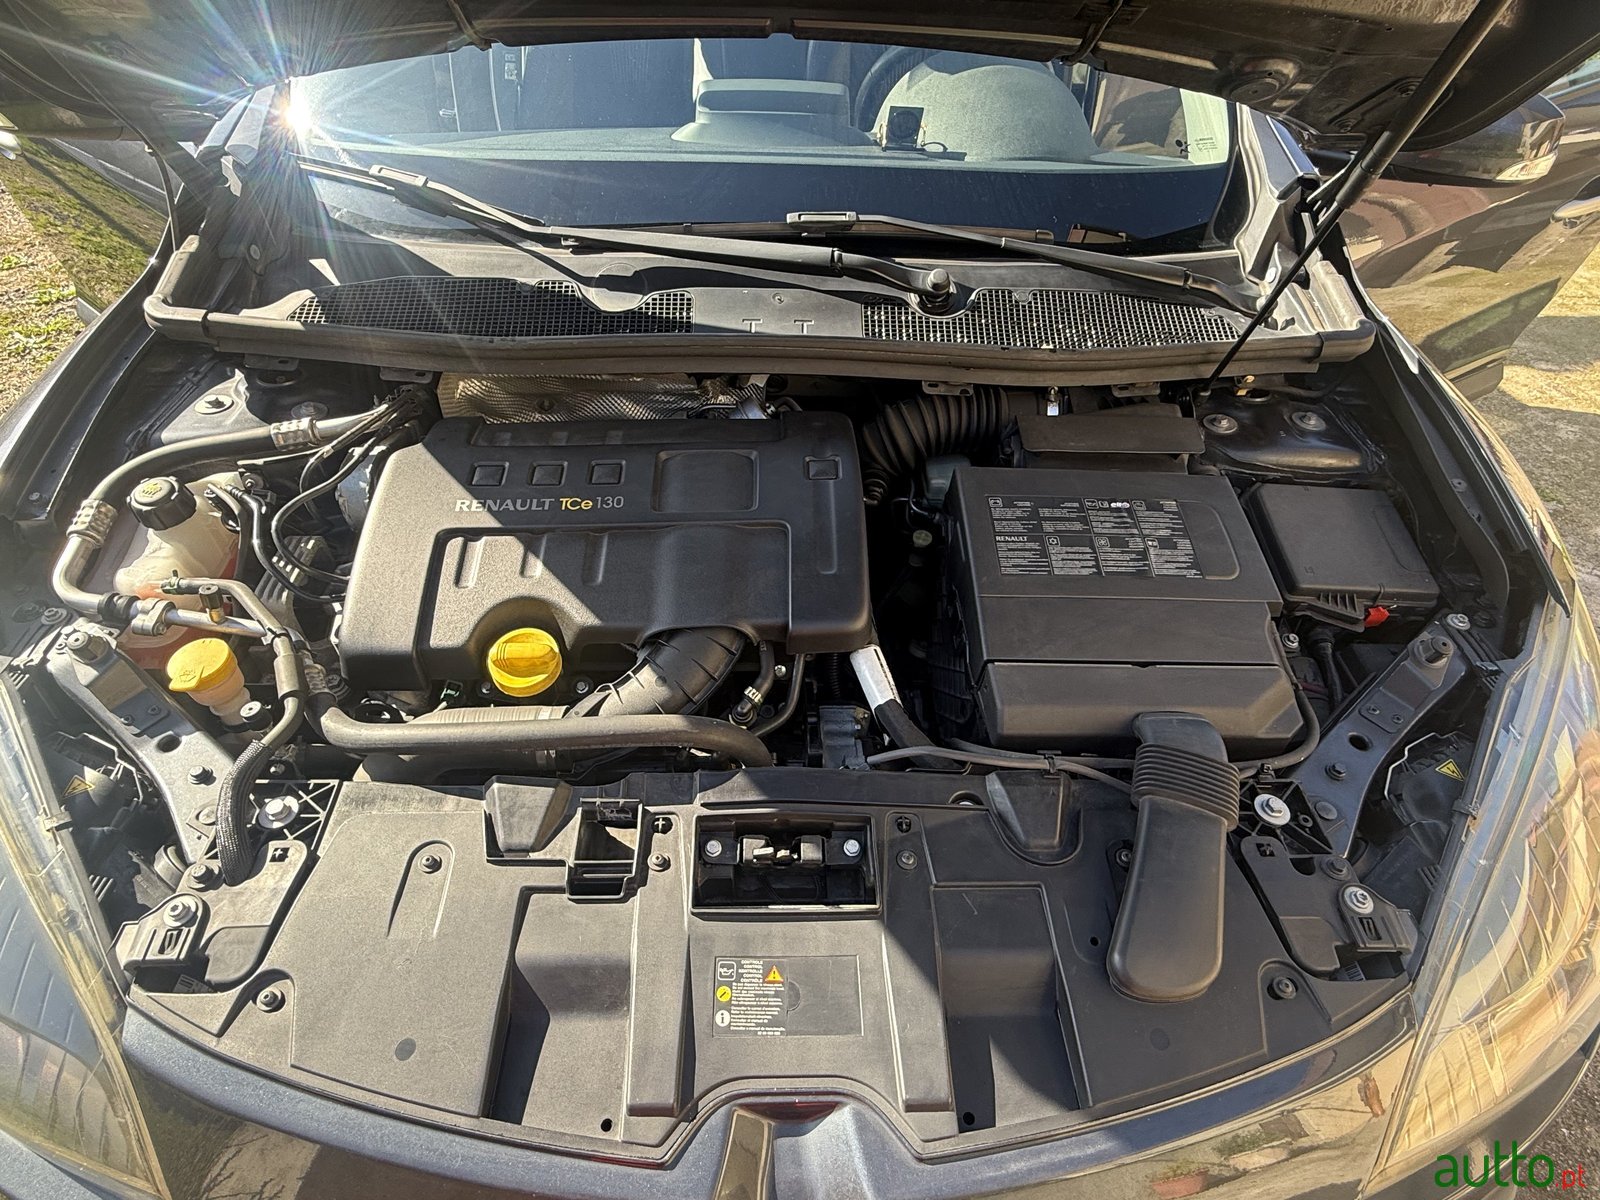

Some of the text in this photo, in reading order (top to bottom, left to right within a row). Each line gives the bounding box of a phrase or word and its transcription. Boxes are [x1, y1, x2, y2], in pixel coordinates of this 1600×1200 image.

[454, 496, 624, 512] RENAULT TCe 130
